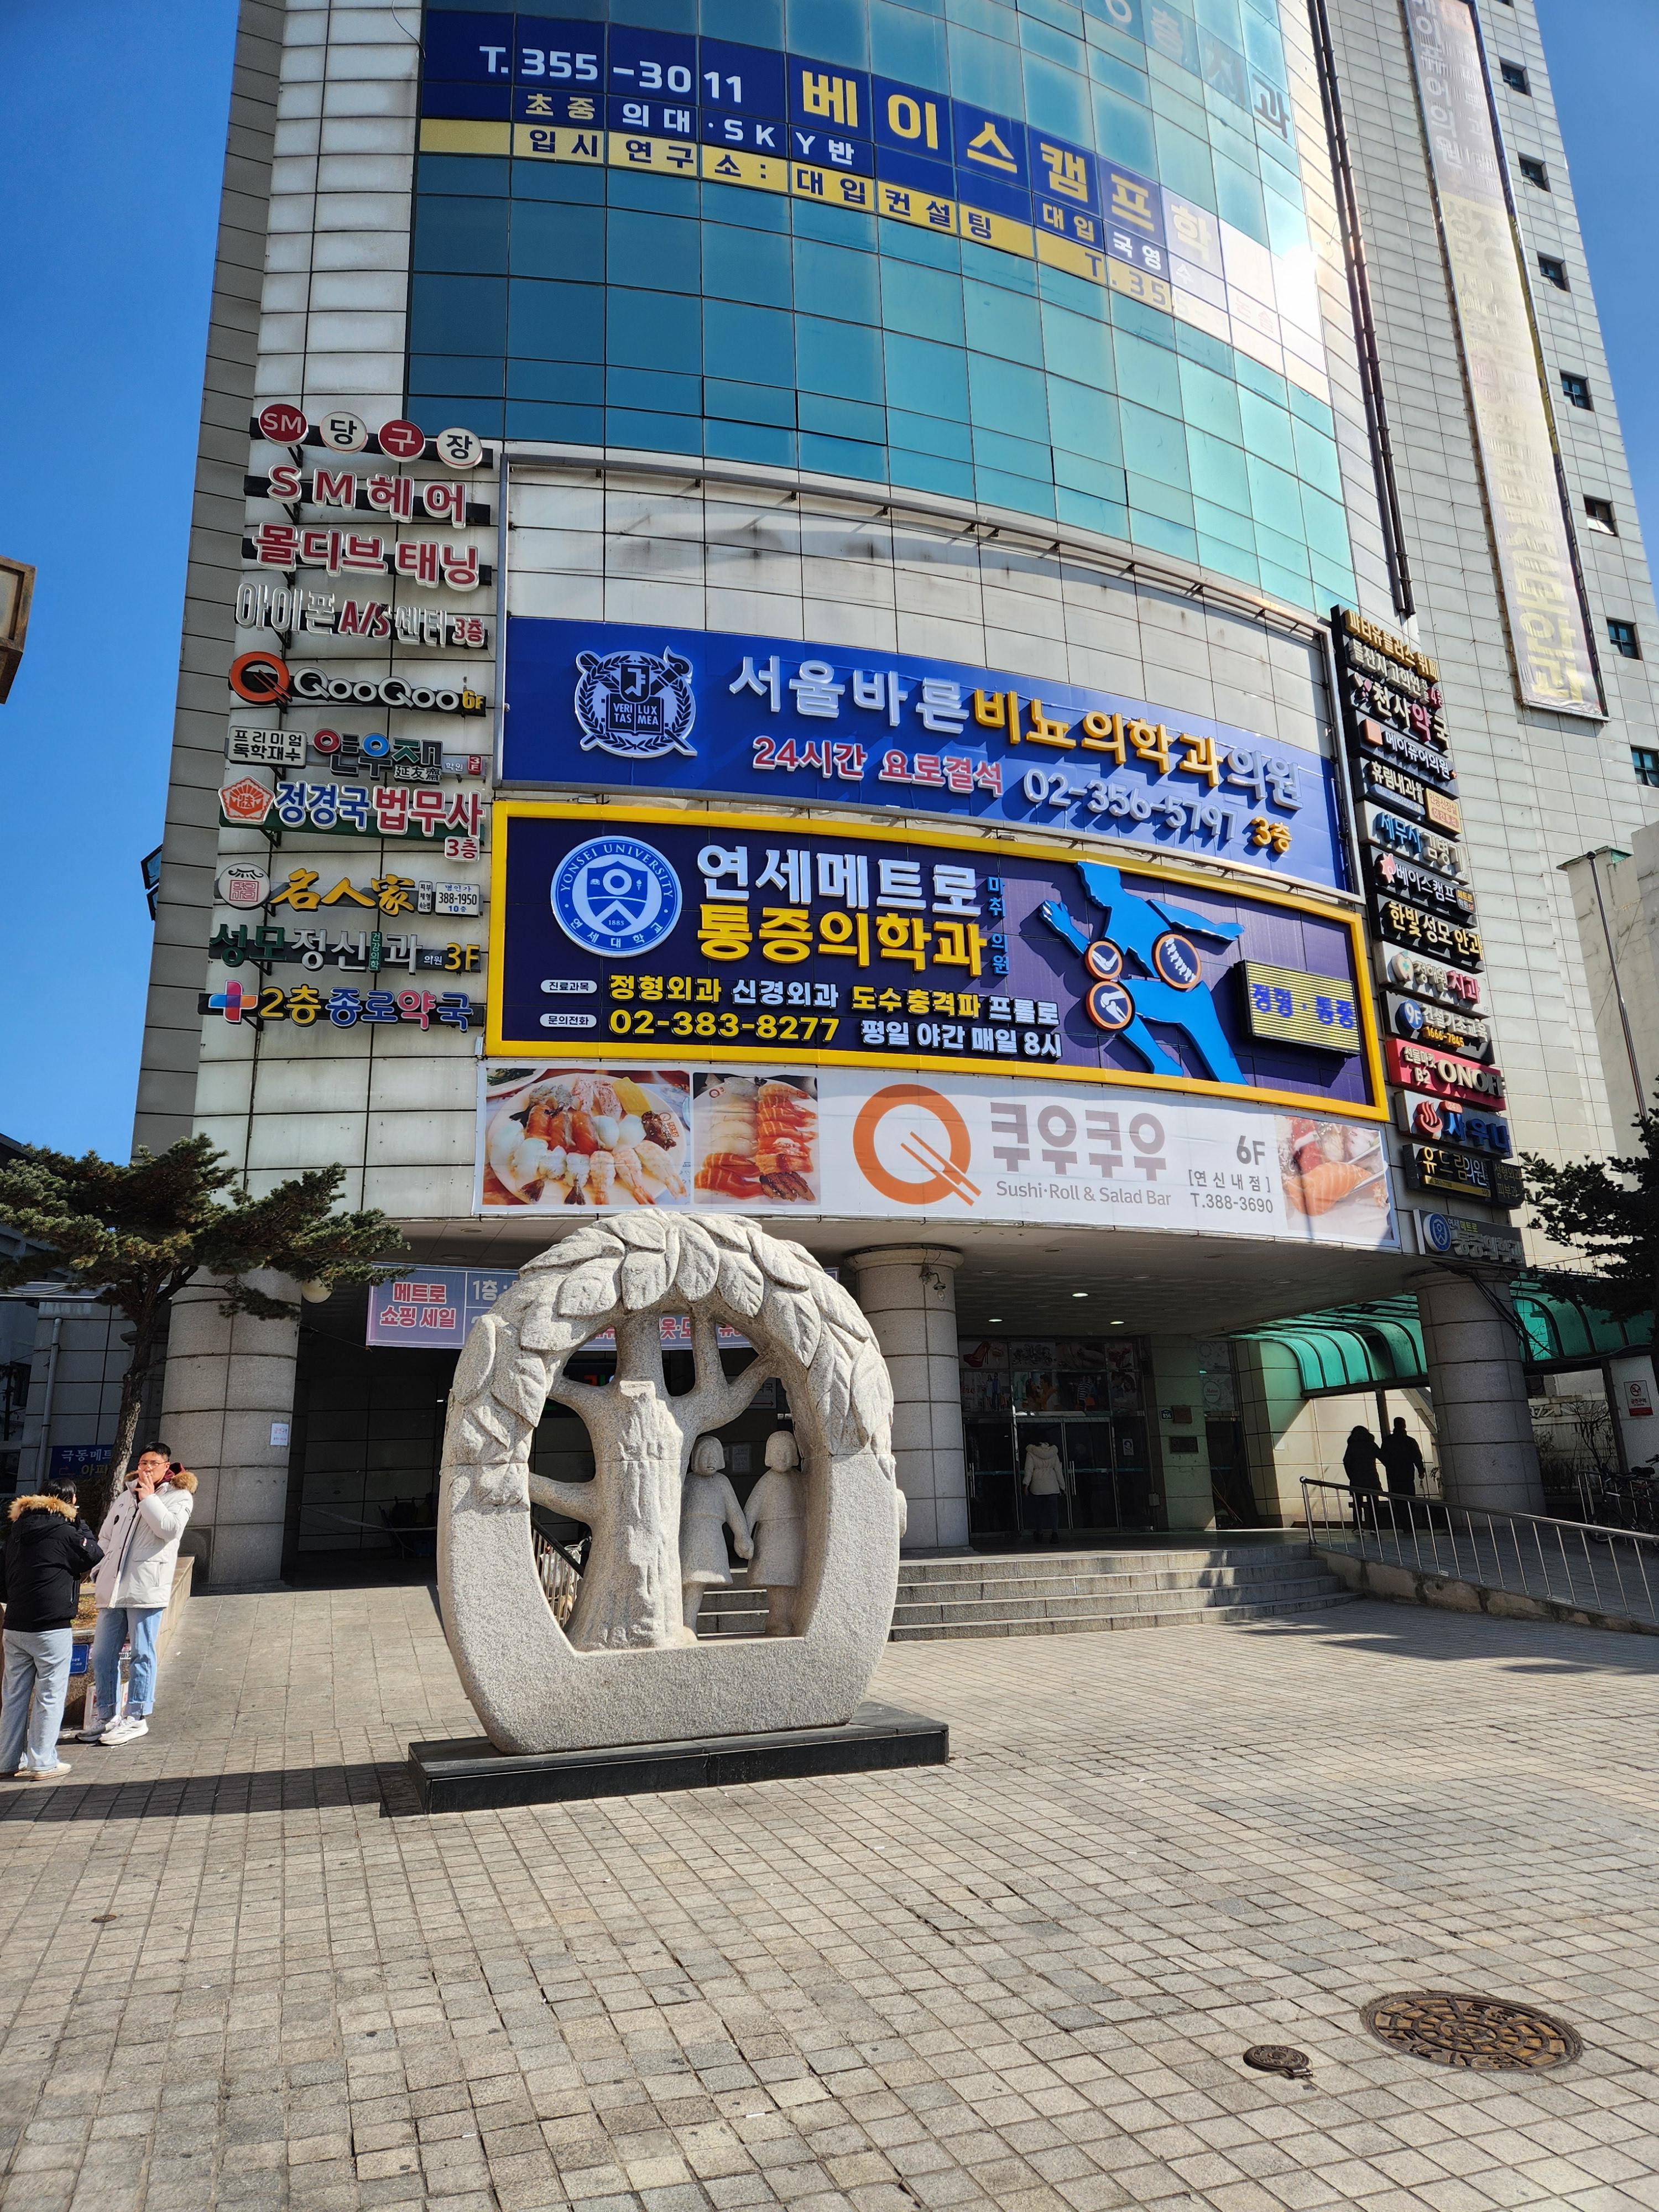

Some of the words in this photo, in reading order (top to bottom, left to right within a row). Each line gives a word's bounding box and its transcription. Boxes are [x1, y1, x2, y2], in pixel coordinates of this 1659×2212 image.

[479, 45, 743, 103] T.355-3011
[263, 413, 302, 434] SM
[330, 420, 472, 460] 당구장
[252, 521, 388, 576] 몰디브
[395, 540, 479, 592] 태닝
[236, 582, 335, 635] 아이폰
[452, 616, 485, 648] 3층
[294, 667, 460, 711] QooQoo
[462, 690, 484, 710] 6F
[613, 702, 633, 714] VERI
[614, 713, 632, 724] TAS
[637, 705, 658, 715] LUX
[637, 716, 659, 726] MEA
[1370, 681, 1451, 752] 천사약국
[233, 729, 302, 748] 프리미엄
[233, 743, 302, 763] 독학재수
[1383, 731, 1451, 781] 메이퓨어의원
[446, 761, 463, 772] 학원
[753, 735, 868, 781] 24시간
[878, 749, 1005, 798] 요로결석
[1370, 760, 1417, 802] 휴림내과
[1022, 768, 1239, 841] 02-356-5797
[446, 838, 479, 859] 3층
[1251, 815, 1294, 854] 3층
[1376, 812, 1421, 853] 세무사
[560, 848, 598, 892] YONSEI
[603, 843, 674, 898] UNIVERSITY
[697, 844, 982, 917] 연세메트로
[1396, 862, 1457, 902] 베이스캠프
[270, 868, 416, 916] 名人家
[438, 892, 477, 905] 388-1950
[445, 884, 472, 893] 명인가
[570, 918, 664, 948] 연세대학교
[697, 904, 987, 977] 통증의학과
[1388, 900, 1453, 945] 한빛성모
[1454, 929, 1484, 961] 안과
[424, 954, 442, 967] 의원
[444, 941, 481, 973] 3F
[549, 980, 589, 992] 진료과목
[609, 974, 722, 1003] 정형외과
[732, 979, 839, 1009] 신경외과
[852, 985, 981, 1020] 도수충격파
[989, 995, 1060, 1026] 프롤로
[259, 984, 324, 1026] 2층
[325, 987, 474, 1030] 종로약국
[547, 1015, 589, 1026] 문의전화
[1405, 1003, 1422, 1026] 9F
[608, 1009, 839, 1041] 02-383-8277
[860, 1019, 910, 1047] 평일
[916, 1022, 966, 1050] 야간
[971, 1026, 1019, 1054] 매일
[1024, 1031, 1062, 1058] 8시
[1423, 1026, 1465, 1048] 1666-7845
[1414, 1067, 1431, 1084] B2
[990, 1101, 1167, 1181] 쿠우쿠우
[1235, 1134, 1266, 1166] 6F
[1442, 1112, 1510, 1154] 사우나
[1083, 1185, 1097, 1202] &
[1099, 1186, 1143, 1206] Salad
[1146, 1190, 1172, 1207] Bar
[1190, 1192, 1274, 1214] T.388-3690
[393, 1282, 447, 1304] 메트로
[379, 1305, 416, 1327] 쇼핑
[420, 1307, 457, 1329] 세일
